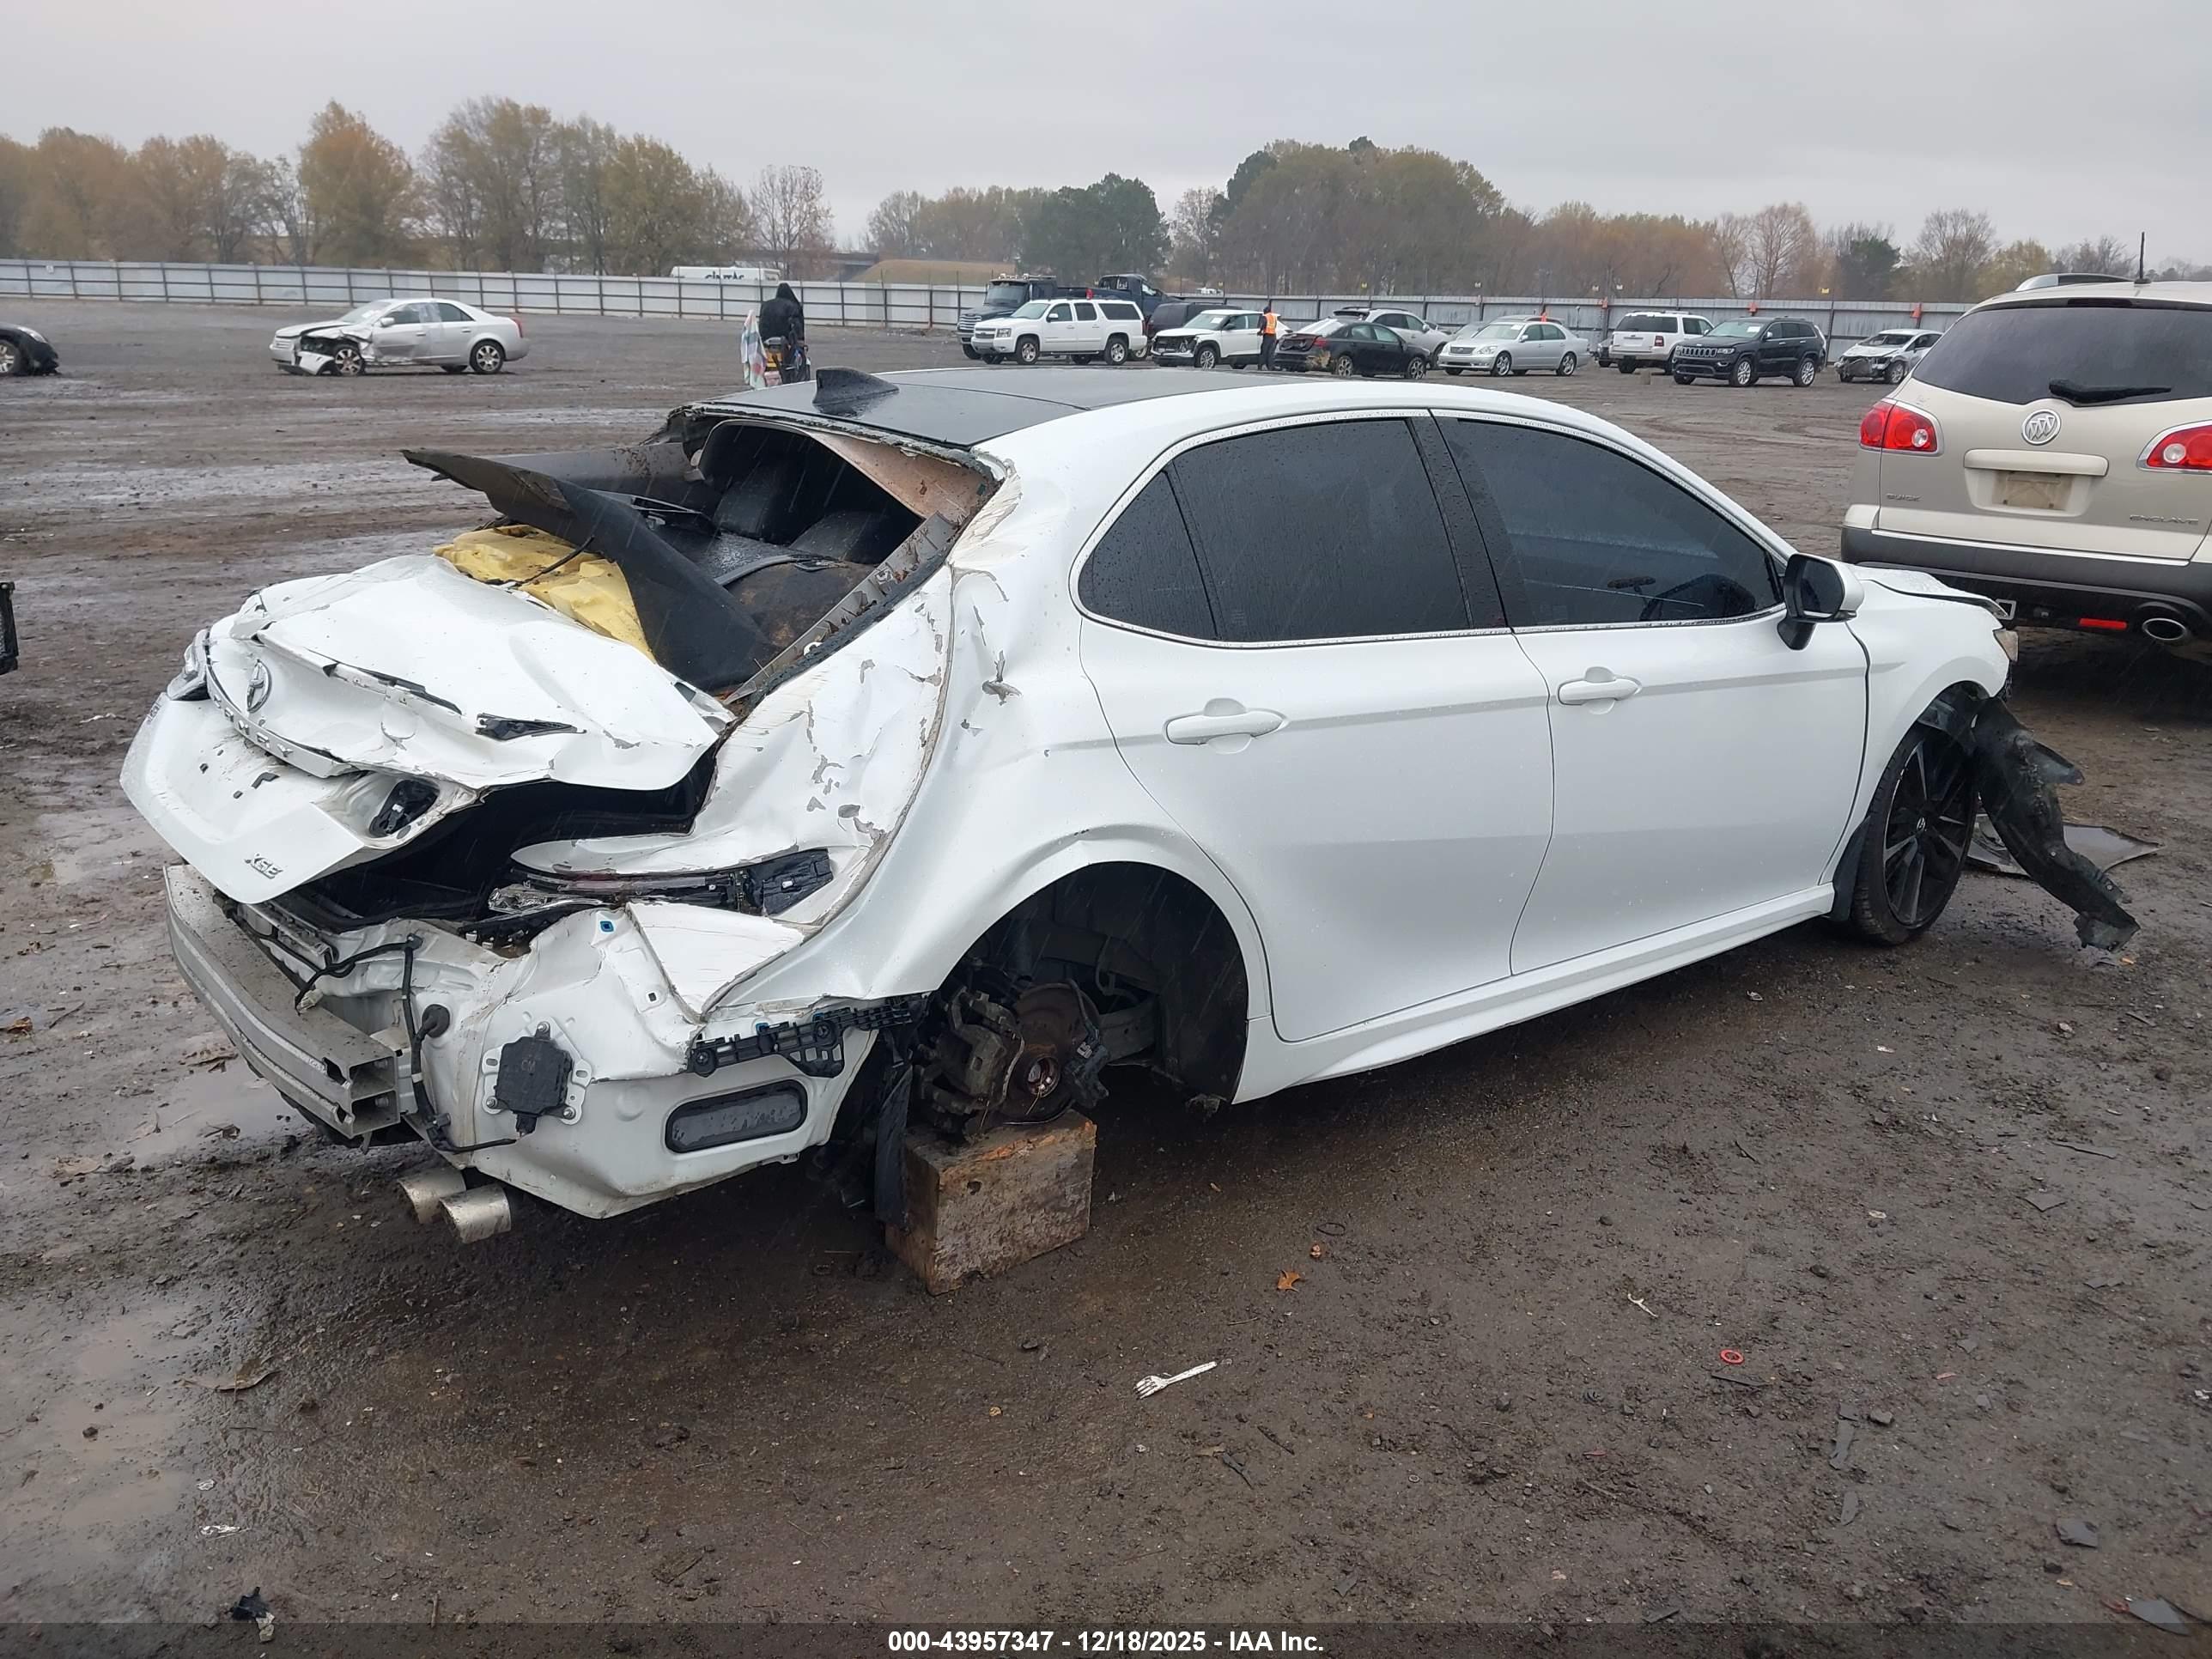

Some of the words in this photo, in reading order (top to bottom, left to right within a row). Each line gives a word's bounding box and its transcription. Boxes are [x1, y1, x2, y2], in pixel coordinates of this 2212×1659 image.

[1886, 493, 1923, 502] BUICK
[2129, 514, 2199, 526] ENCLAVE
[244, 853, 284, 880] XSE
